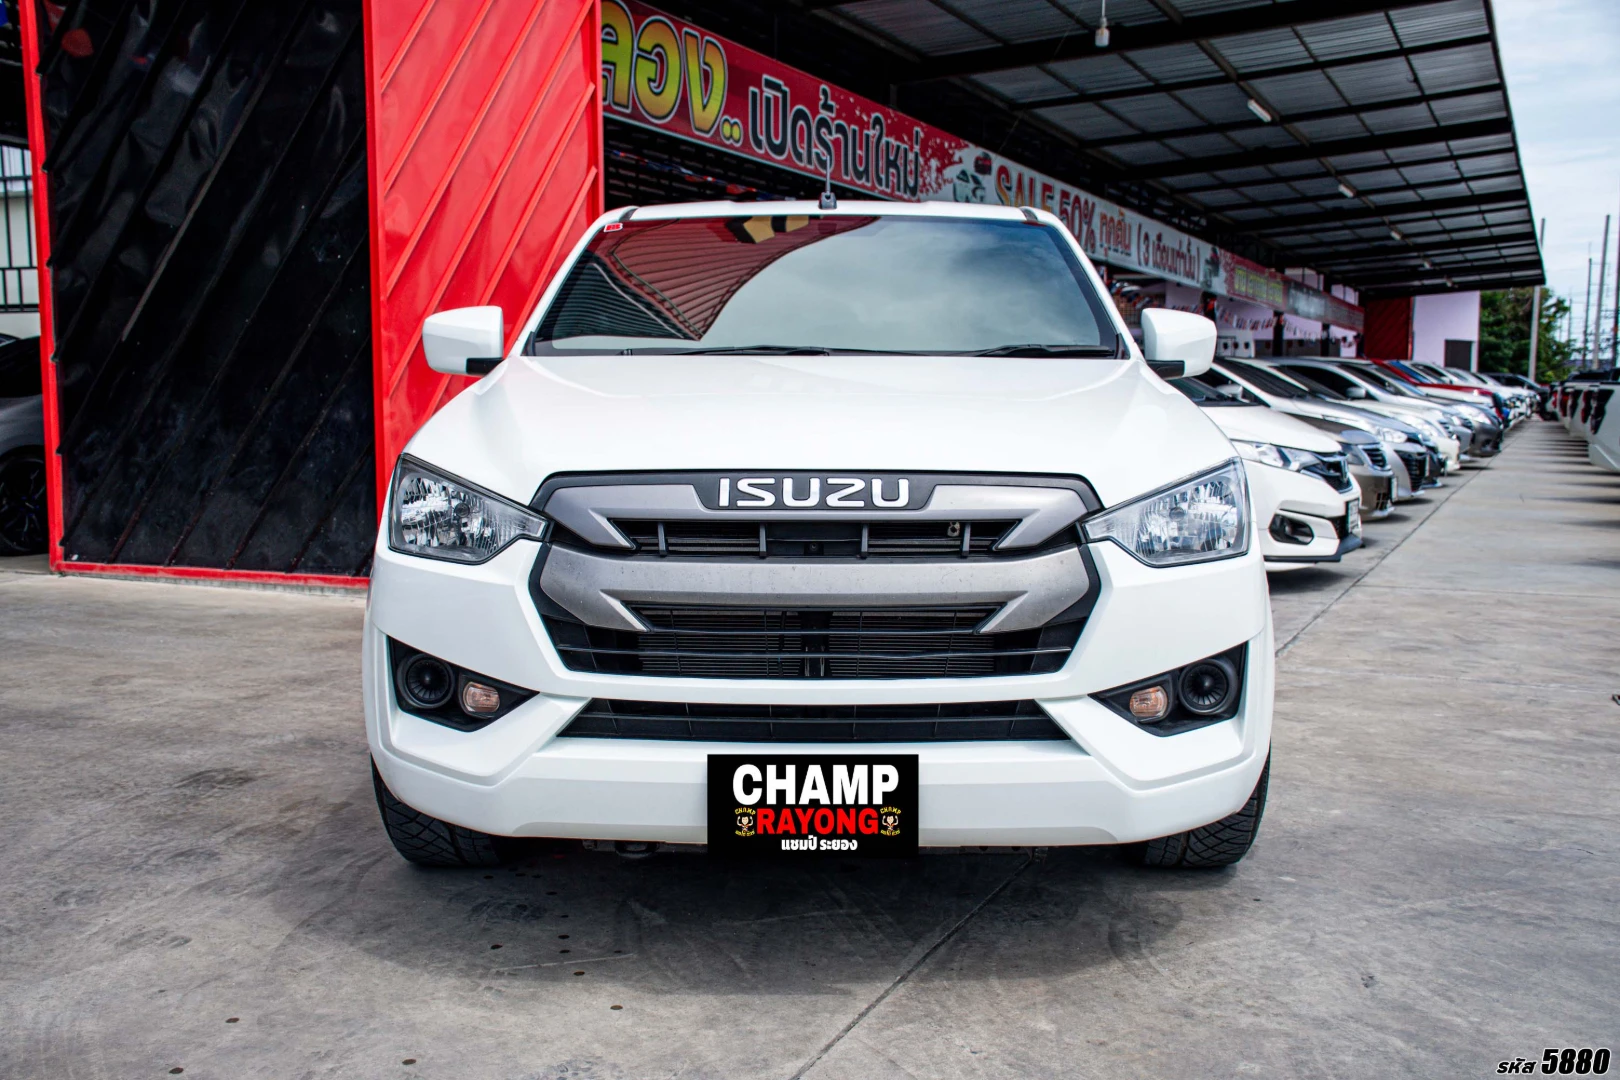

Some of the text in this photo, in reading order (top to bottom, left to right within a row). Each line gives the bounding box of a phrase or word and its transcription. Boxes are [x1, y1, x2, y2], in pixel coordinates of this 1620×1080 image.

[749, 74, 921, 199] เปิดร้านใหม่
[1059, 188, 1096, 254] 50%
[718, 477, 910, 508] ISUZU
